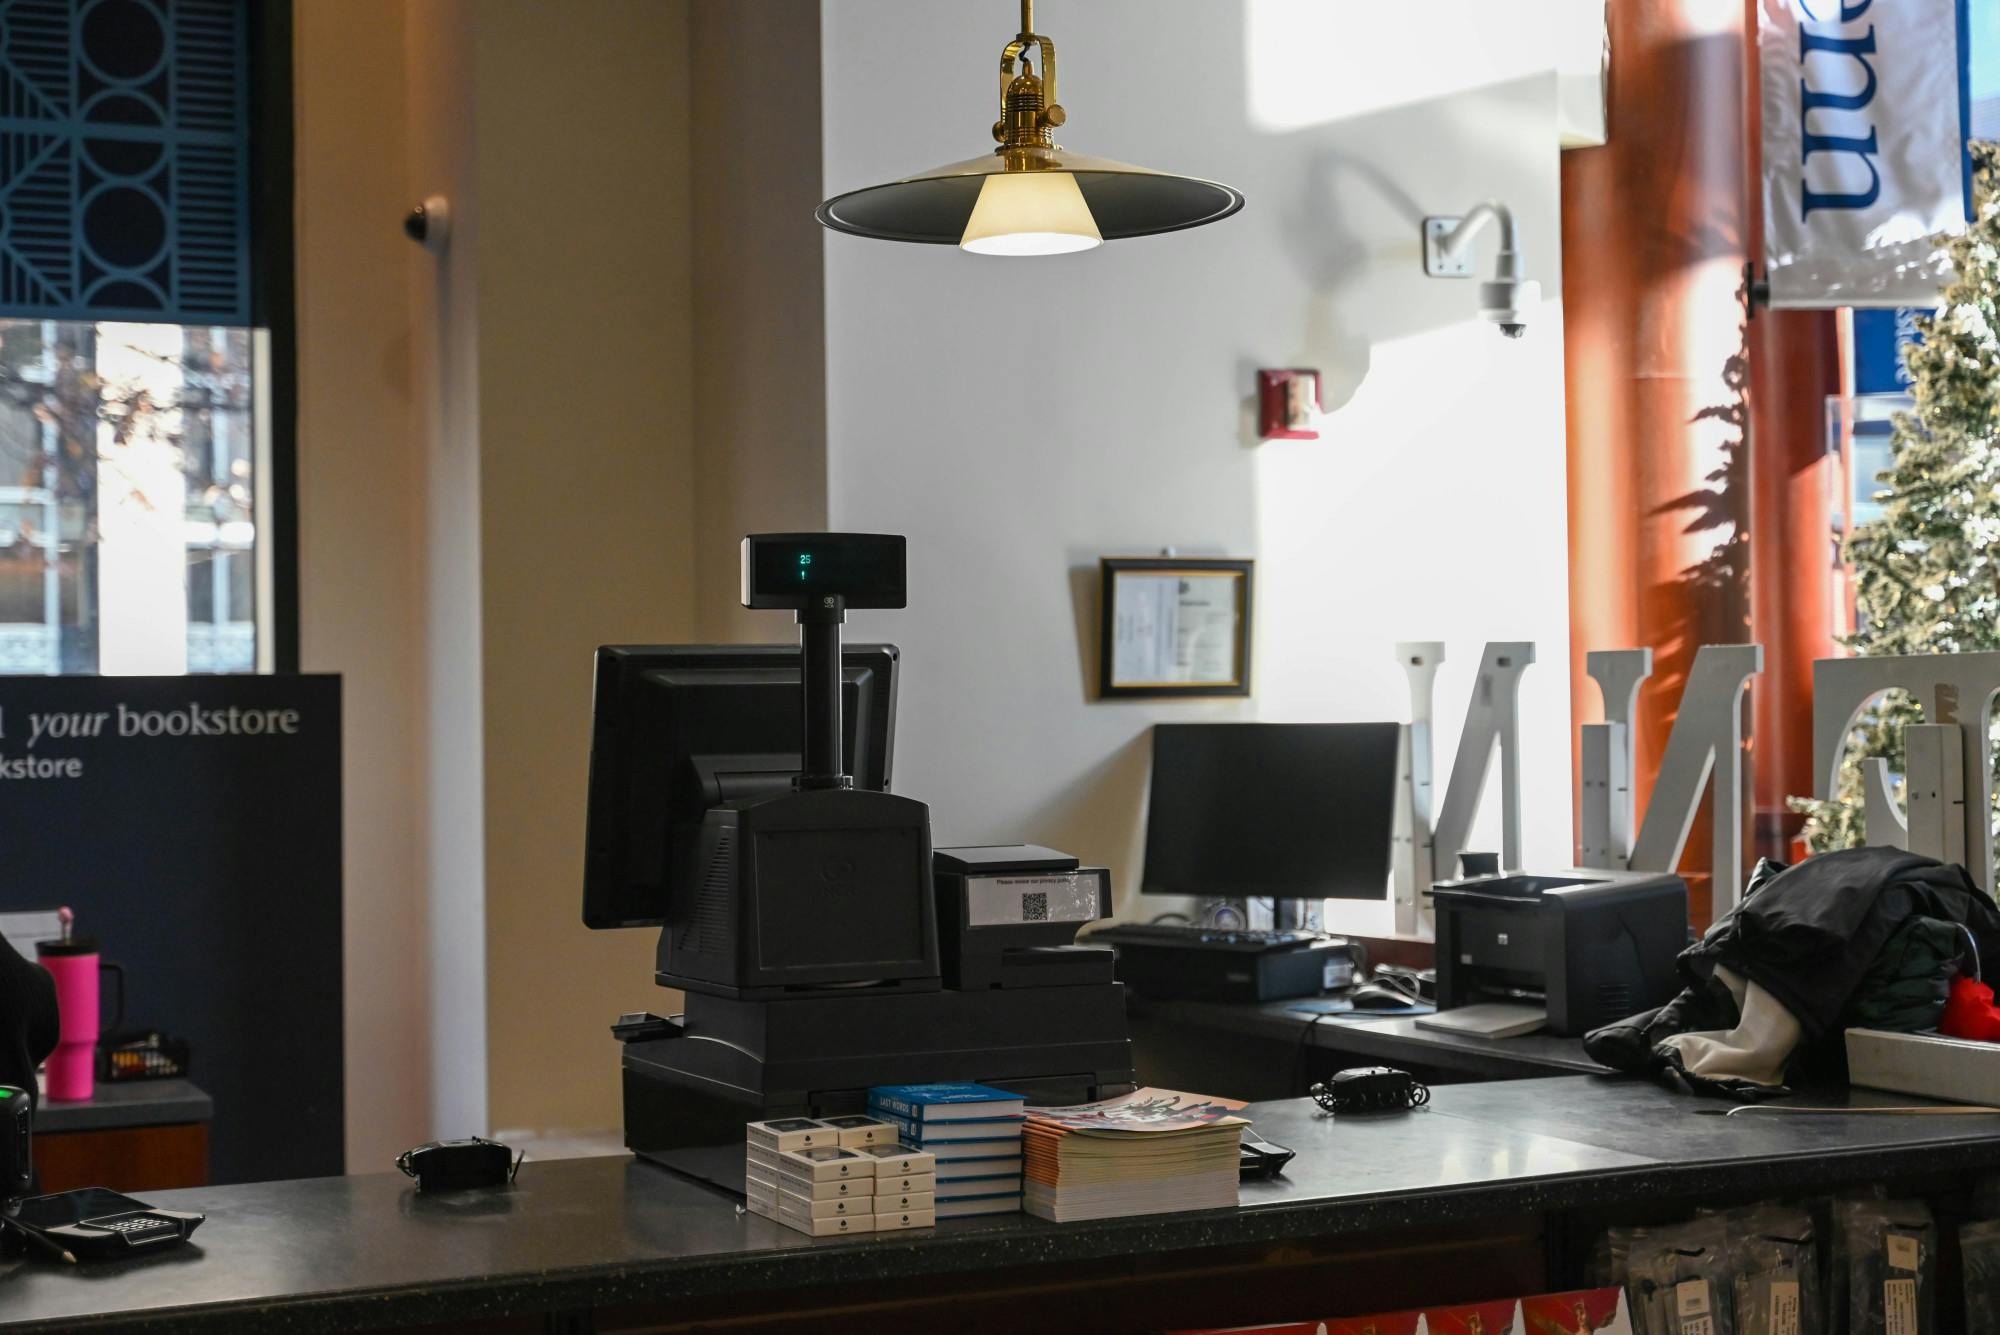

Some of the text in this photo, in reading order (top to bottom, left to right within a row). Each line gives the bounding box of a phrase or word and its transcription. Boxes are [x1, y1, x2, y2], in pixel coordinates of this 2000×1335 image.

[800, 554, 811, 564] 25
[27, 711, 109, 748] your
[117, 703, 299, 736] bookstore
